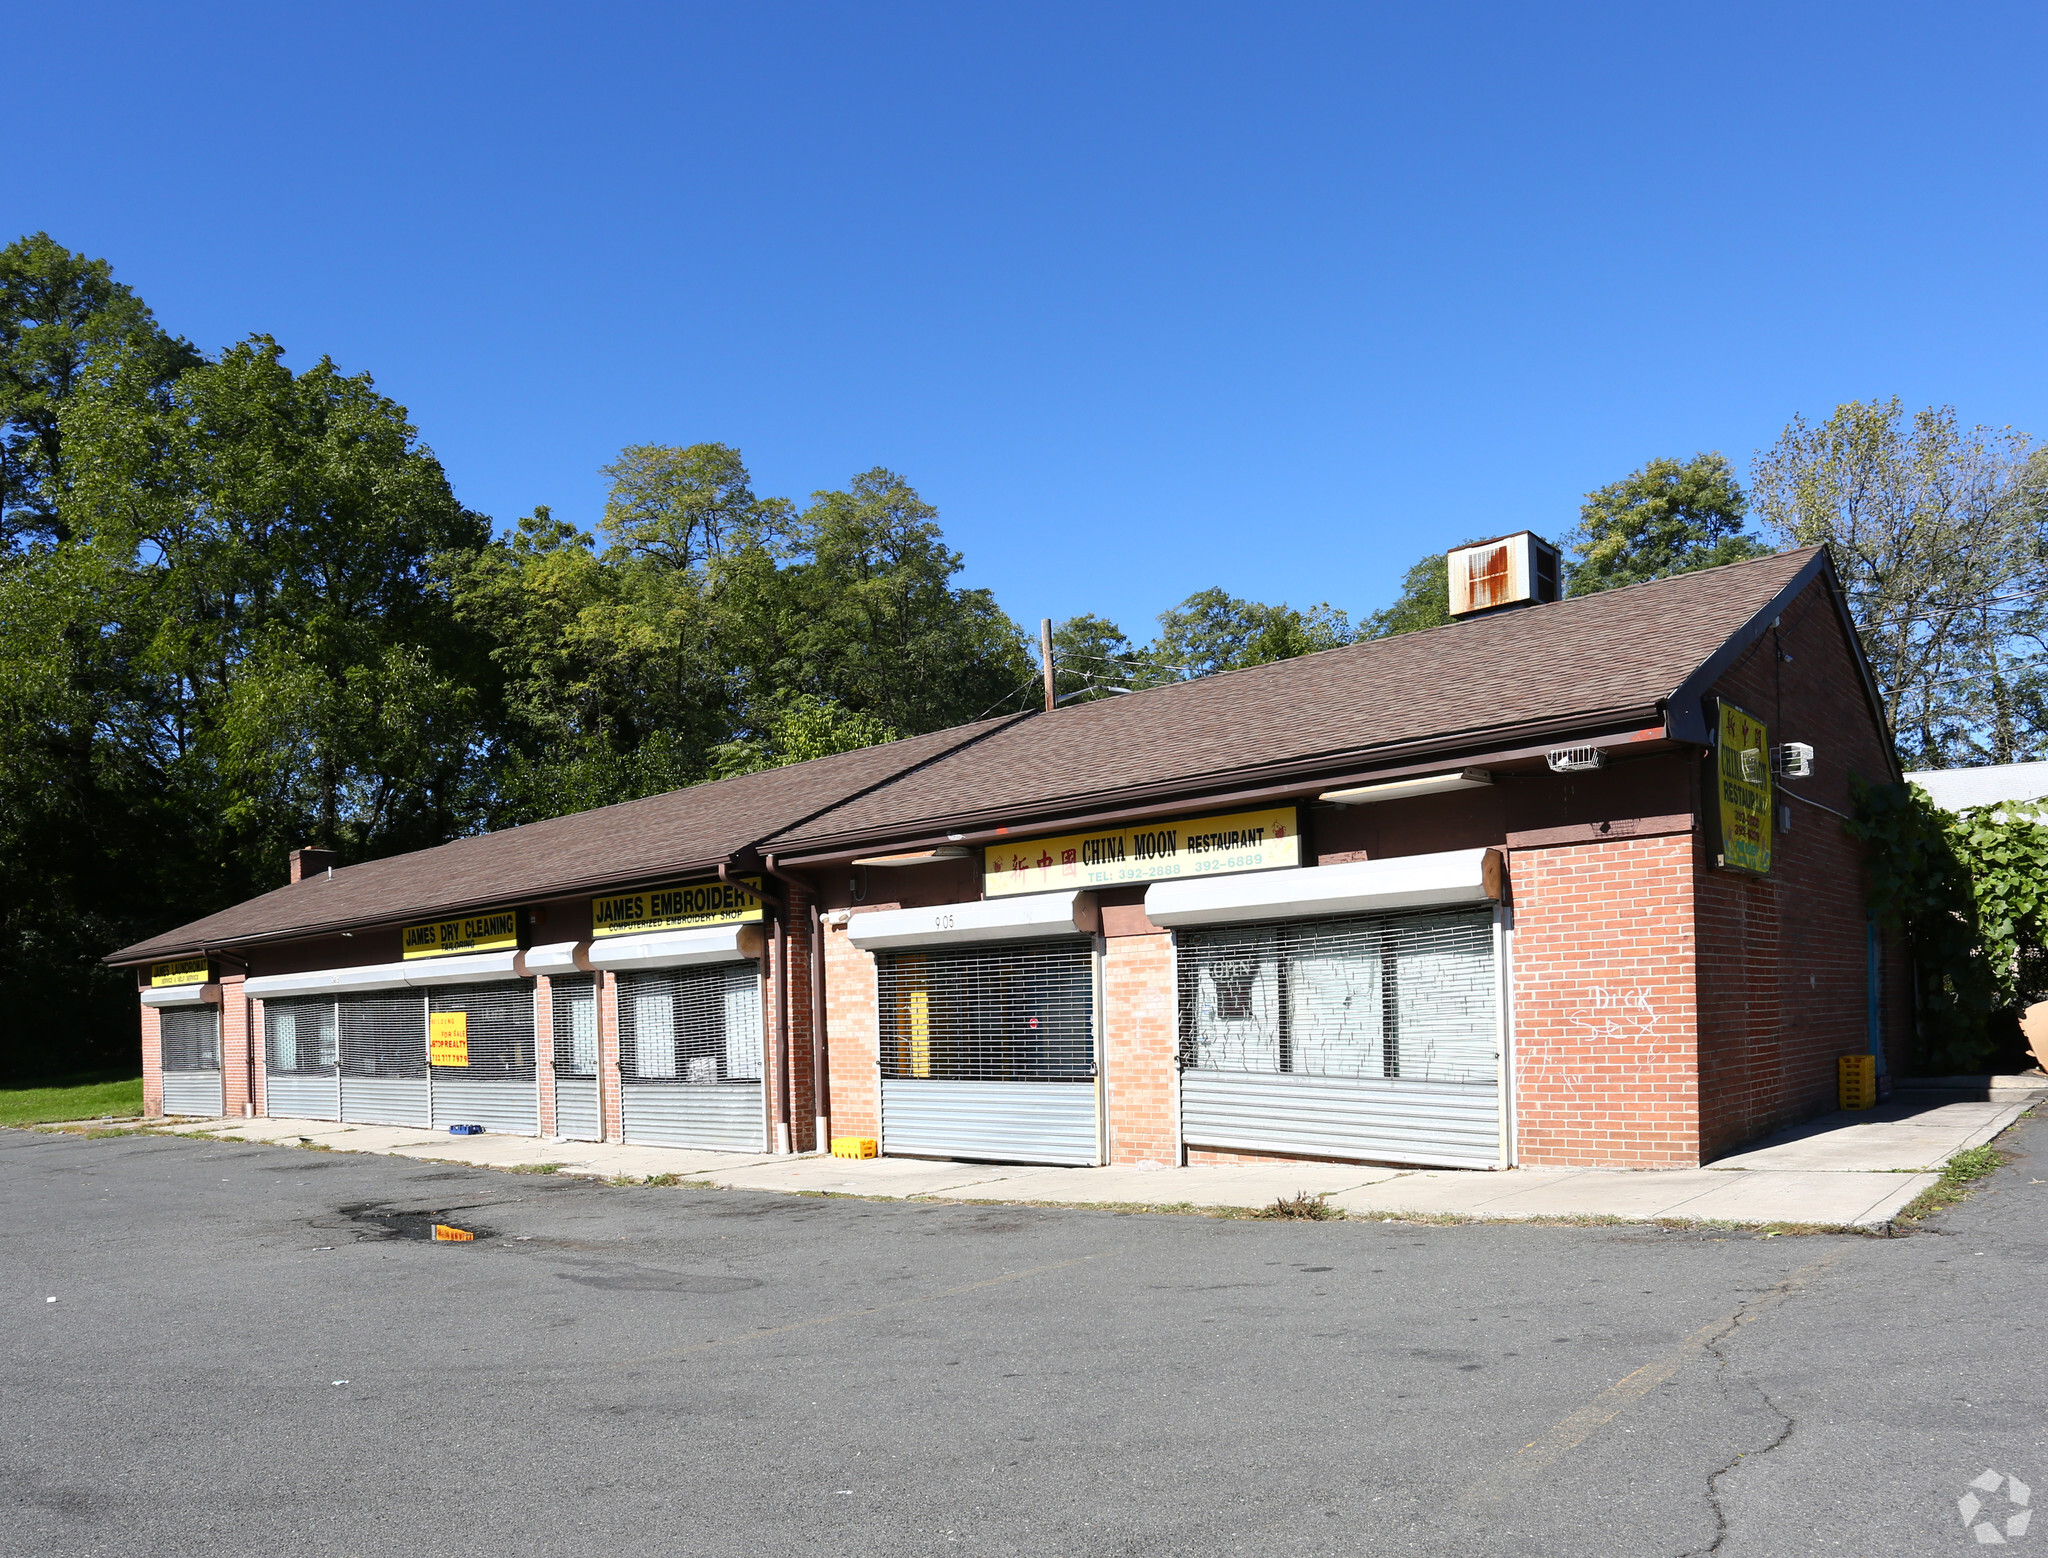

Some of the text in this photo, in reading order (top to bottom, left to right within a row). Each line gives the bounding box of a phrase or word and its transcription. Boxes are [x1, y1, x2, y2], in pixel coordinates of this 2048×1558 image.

[1082, 827, 1264, 866] CHINA MOON RESTAURANT
[1088, 854, 1262, 882] TEL: 392-2888 392-6889
[596, 881, 758, 923] JAMES EMBROIDERY
[406, 914, 514, 947] JAMES DRY CLEANING
[608, 908, 743, 932] COMPUTERIZED EMBROIDERY SHOP
[441, 939, 475, 951] TAILORING
[1213, 960, 1251, 978] OPEN
[441, 1030, 466, 1039] FOR SALE
